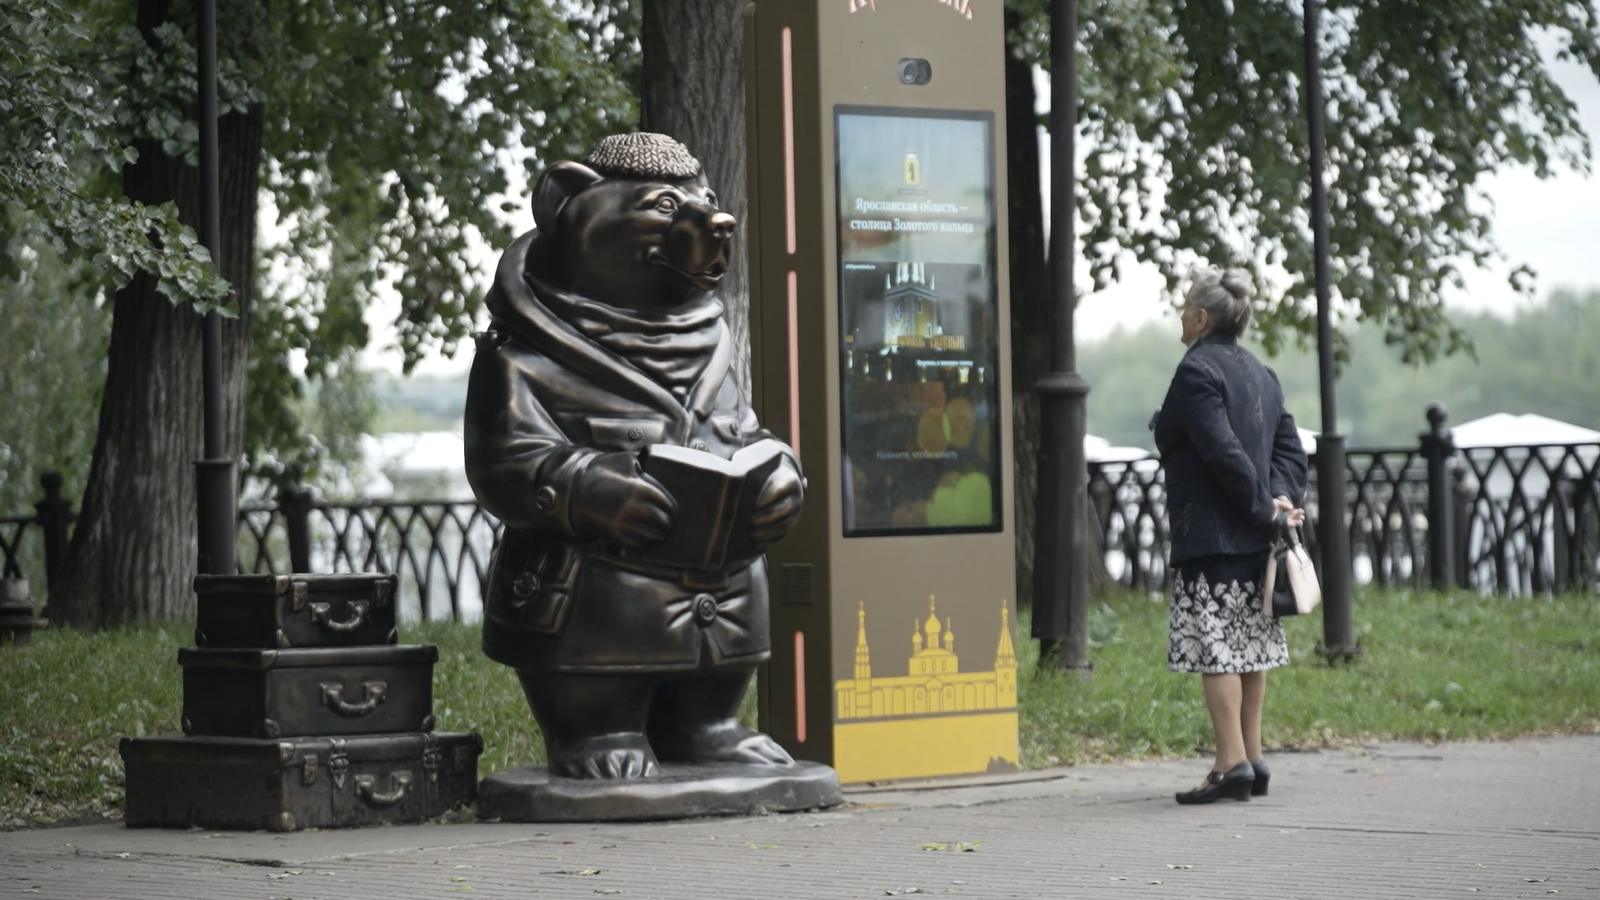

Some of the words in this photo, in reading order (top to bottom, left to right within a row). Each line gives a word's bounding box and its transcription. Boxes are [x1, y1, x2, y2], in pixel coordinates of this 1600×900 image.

[855, 198, 918, 213] Ярославская
[920, 200, 958, 213] область
[850, 219, 892, 232] столица
[894, 218, 938, 231] Золотого
[941, 221, 974, 233] кольца
